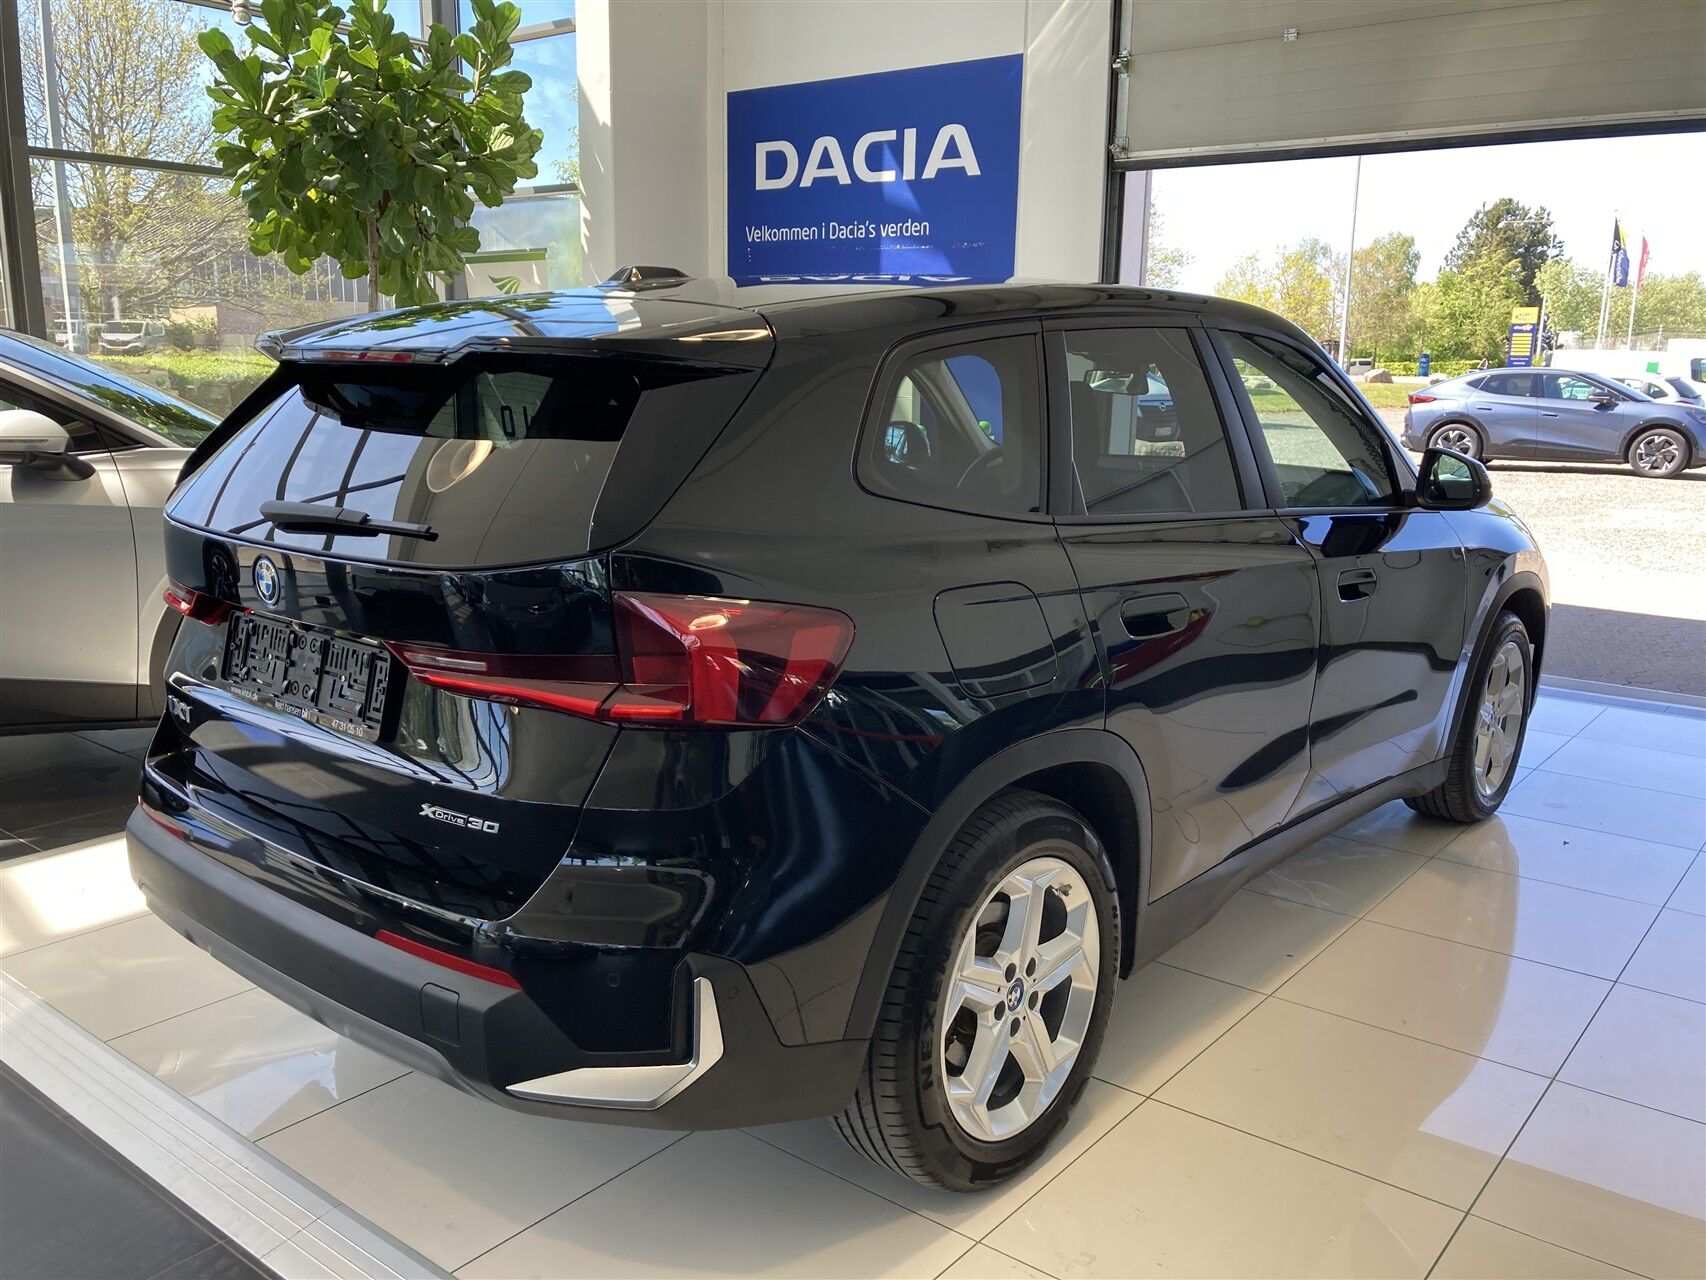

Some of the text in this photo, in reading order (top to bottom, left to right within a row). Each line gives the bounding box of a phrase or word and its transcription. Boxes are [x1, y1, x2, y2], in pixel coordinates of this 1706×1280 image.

[755, 123, 981, 191] DACIA
[745, 218, 930, 242] Velkommen i Dacia's verden
